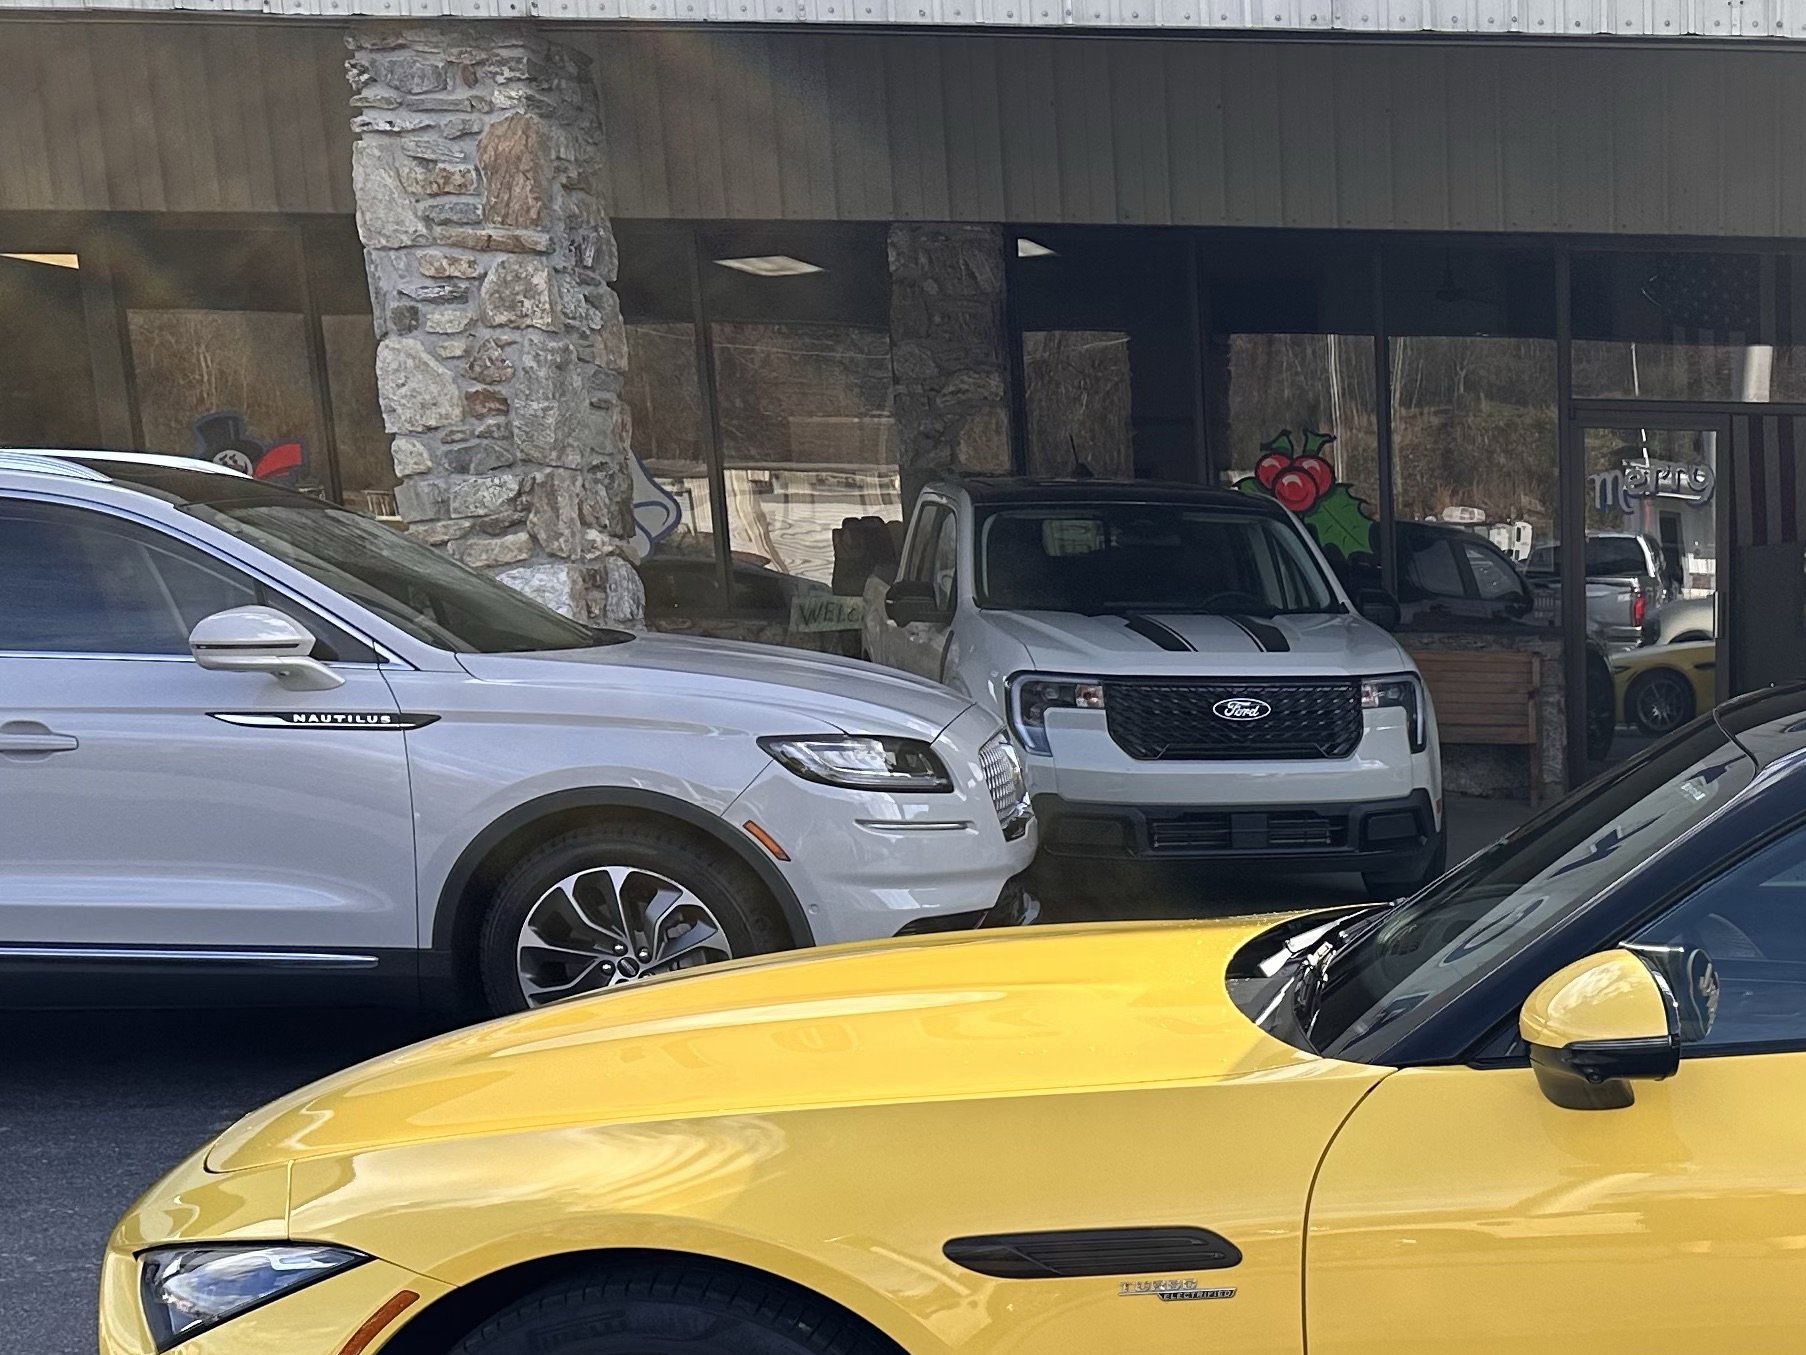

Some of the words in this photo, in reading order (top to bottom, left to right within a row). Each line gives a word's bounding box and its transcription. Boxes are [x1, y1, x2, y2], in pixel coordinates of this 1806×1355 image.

[799, 601, 864, 626] WELC
[1224, 701, 1260, 717] Ford
[293, 713, 391, 724] NAUTILUS
[1119, 1279, 1197, 1293] TURBO
[1162, 1289, 1233, 1300] ELECTRIFIED
